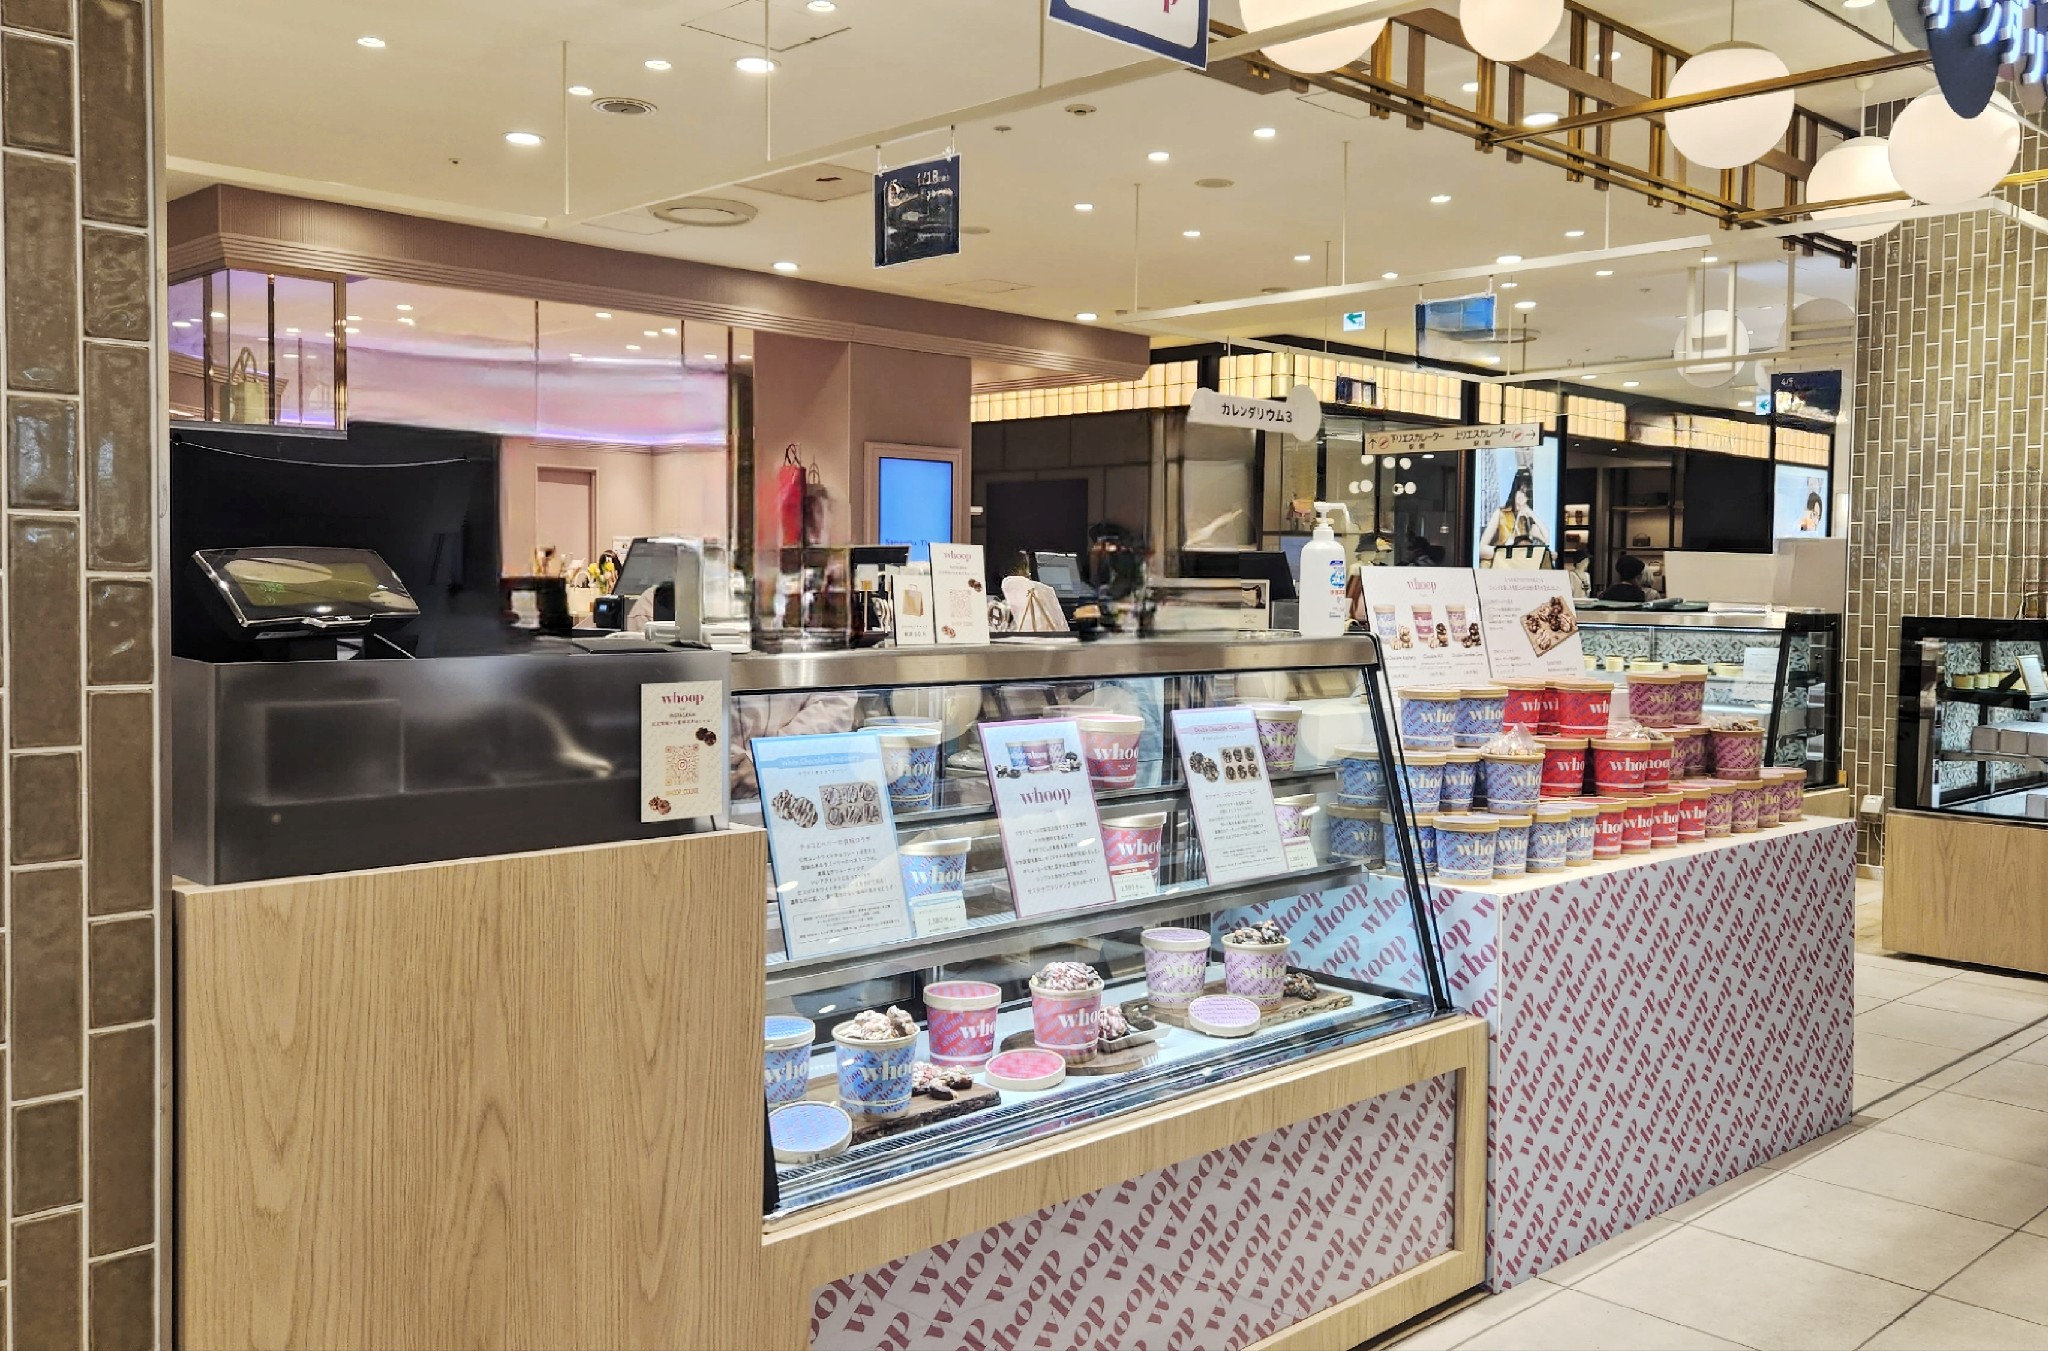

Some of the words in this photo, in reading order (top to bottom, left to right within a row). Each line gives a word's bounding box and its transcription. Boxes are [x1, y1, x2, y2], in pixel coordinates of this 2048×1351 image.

[1222, 402, 1293, 423] カレンダリウム3
[661, 692, 704, 705] whoop
[1019, 786, 1071, 806] whoop
[1302, 883, 1368, 949] whoop
[1304, 1134, 1363, 1242] whoop
[1343, 1112, 1400, 1216] whoop
[1374, 1151, 1429, 1256] whoop
[1147, 1203, 1218, 1325] whoop
[1195, 1176, 1261, 1293] whoop
[1205, 1213, 1271, 1330] whoop
[1249, 1186, 1312, 1300] whoop
[1337, 1175, 1394, 1282] whoop
[1034, 1218, 1114, 1348] whoop
